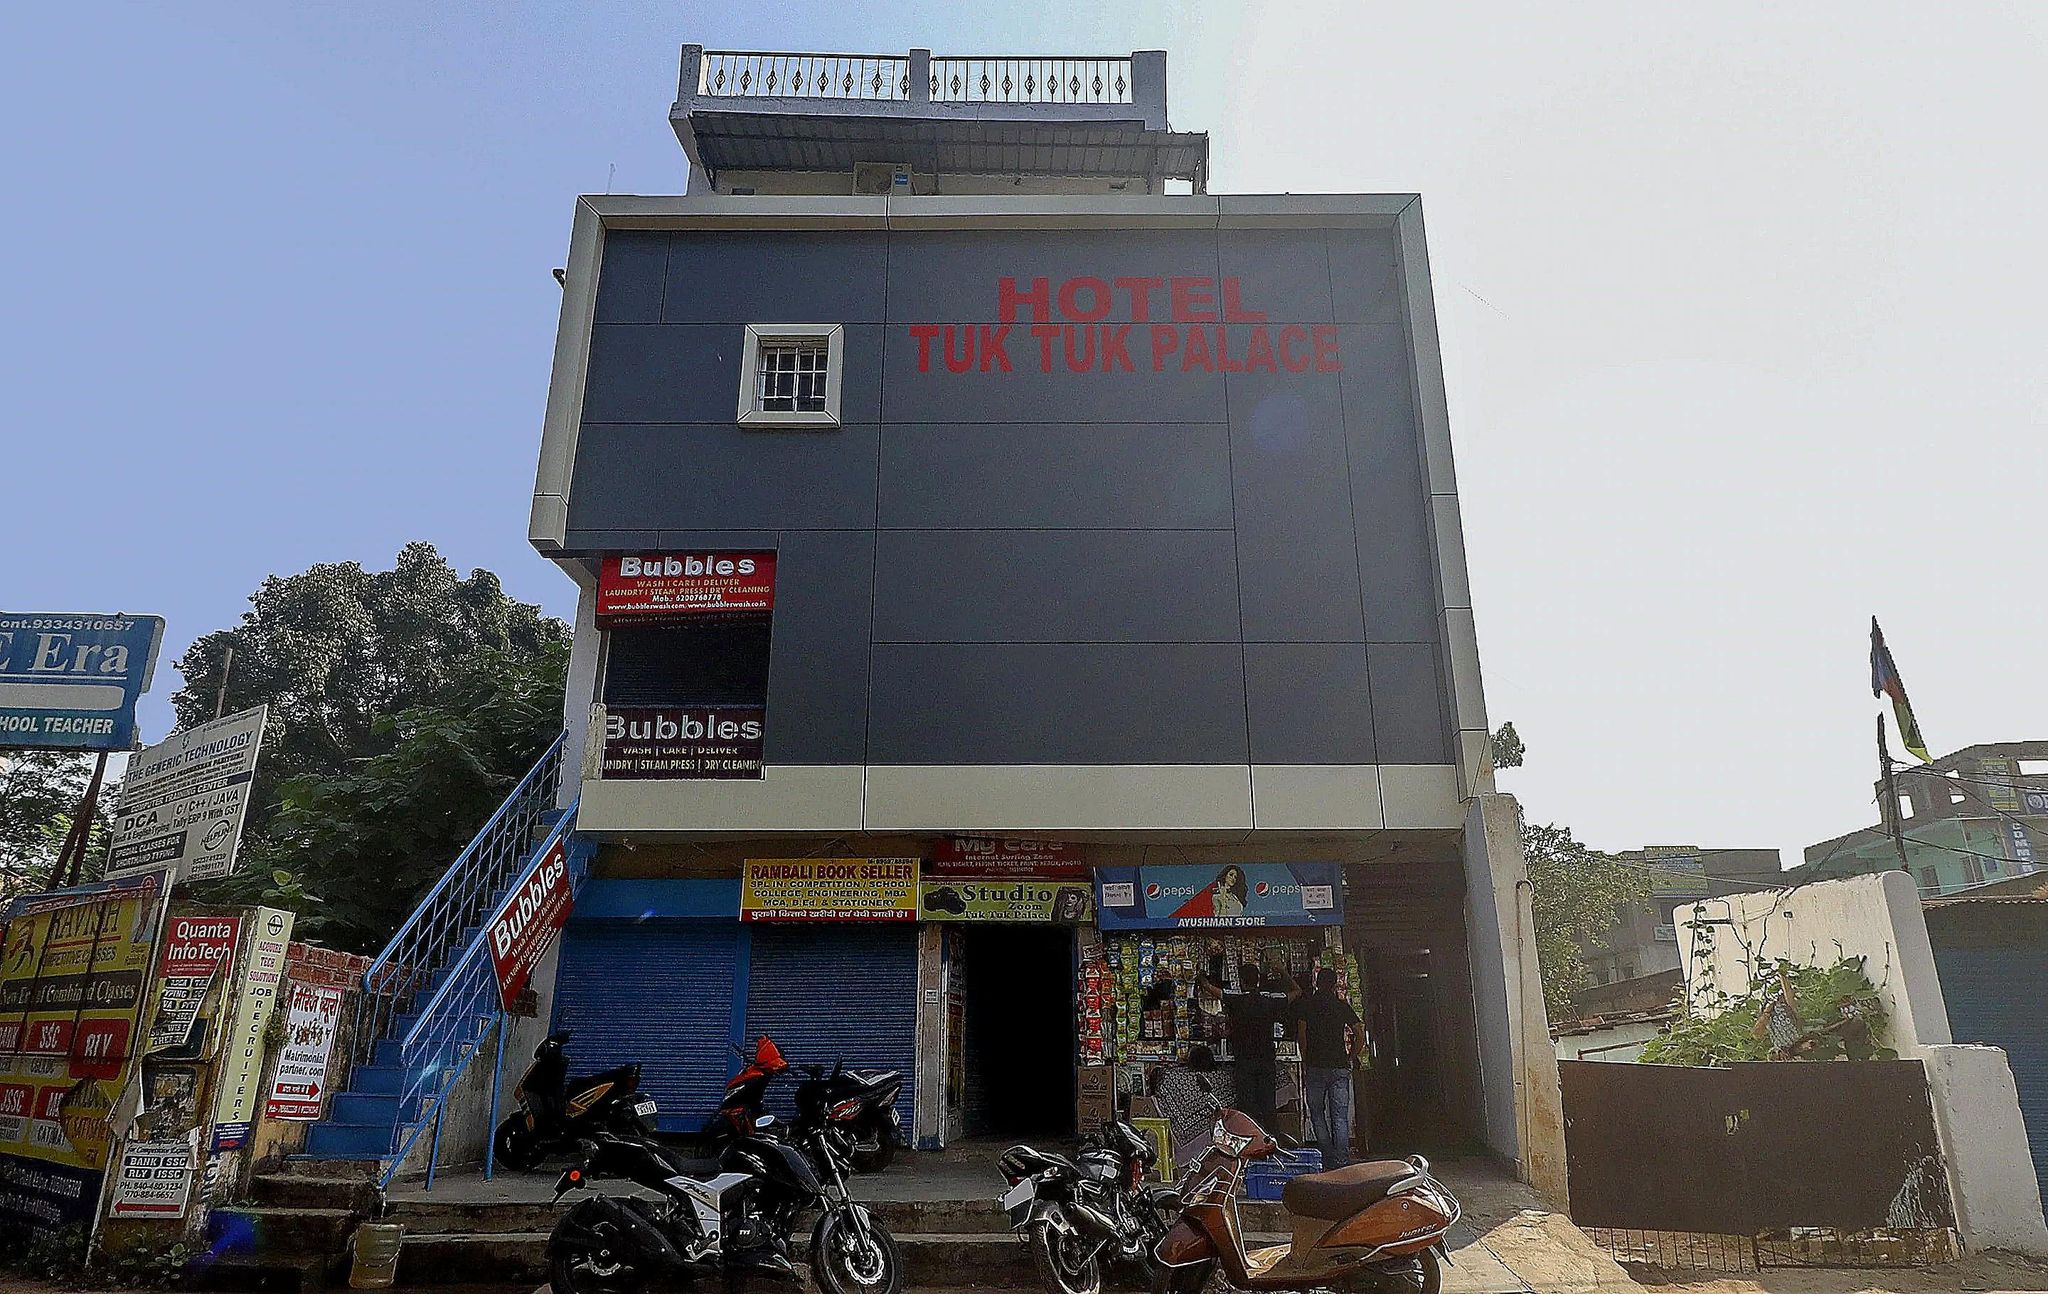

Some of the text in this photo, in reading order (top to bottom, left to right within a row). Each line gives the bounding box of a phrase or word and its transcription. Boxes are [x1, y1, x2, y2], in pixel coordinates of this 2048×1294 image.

[999, 276, 1267, 322] HOTEL
[909, 324, 1344, 373] TUK TUK PALACE
[620, 555, 756, 577] Bubbles
[605, 589, 643, 597] LAUNDRY
[679, 587, 705, 595] PRESS
[729, 586, 770, 594] CLEANING
[637, 580, 664, 588] WASH
[704, 578, 740, 586] DELIVER
[27, 632, 129, 673] Era
[44, 717, 114, 734] TEACHER
[606, 714, 762, 740] Bubbles
[127, 771, 143, 783] THE
[144, 753, 182, 778] GENERIC
[184, 730, 254, 763] TECHNOLOGY
[640, 759, 668, 770] STEAM
[670, 759, 695, 770] PRESS
[197, 779, 229, 793] CENTER
[123, 810, 158, 832] DCA
[212, 788, 239, 806] JAVA
[173, 817, 187, 828] Tally
[187, 811, 201, 825] ERP
[224, 802, 240, 816] GST
[200, 823, 235, 846] HELPLINE
[138, 837, 167, 853] CLASSES
[167, 835, 180, 845] FOR
[954, 838, 996, 855] My
[750, 865, 913, 879] RAMBALI BOOK SELLER
[753, 890, 804, 898] COLLEGE,
[807, 890, 881, 898] ENGINEERING,
[961, 883, 1053, 902] Studio
[1163, 884, 1195, 898] pepsi
[1272, 884, 1303, 896] peps
[494, 853, 564, 961] Bubbles
[831, 899, 896, 907] STATIONERY
[1008, 902, 1043, 911] Zoom
[987, 910, 1011, 920] Tuk
[1013, 910, 1052, 920] Palace
[1177, 916, 1266, 928] AYUSHMAN STORE
[177, 920, 232, 940] Quanta
[168, 942, 231, 961] InfoTech
[46, 982, 95, 1003] Combind
[97, 980, 136, 1004] Classes
[250, 987, 273, 997] JOB
[232, 1000, 264, 1121] RECRUITERS
[284, 1048, 326, 1064] Matrimonial
[130, 1157, 186, 1166] BANK SSC
[128, 1169, 148, 1178] RLY
